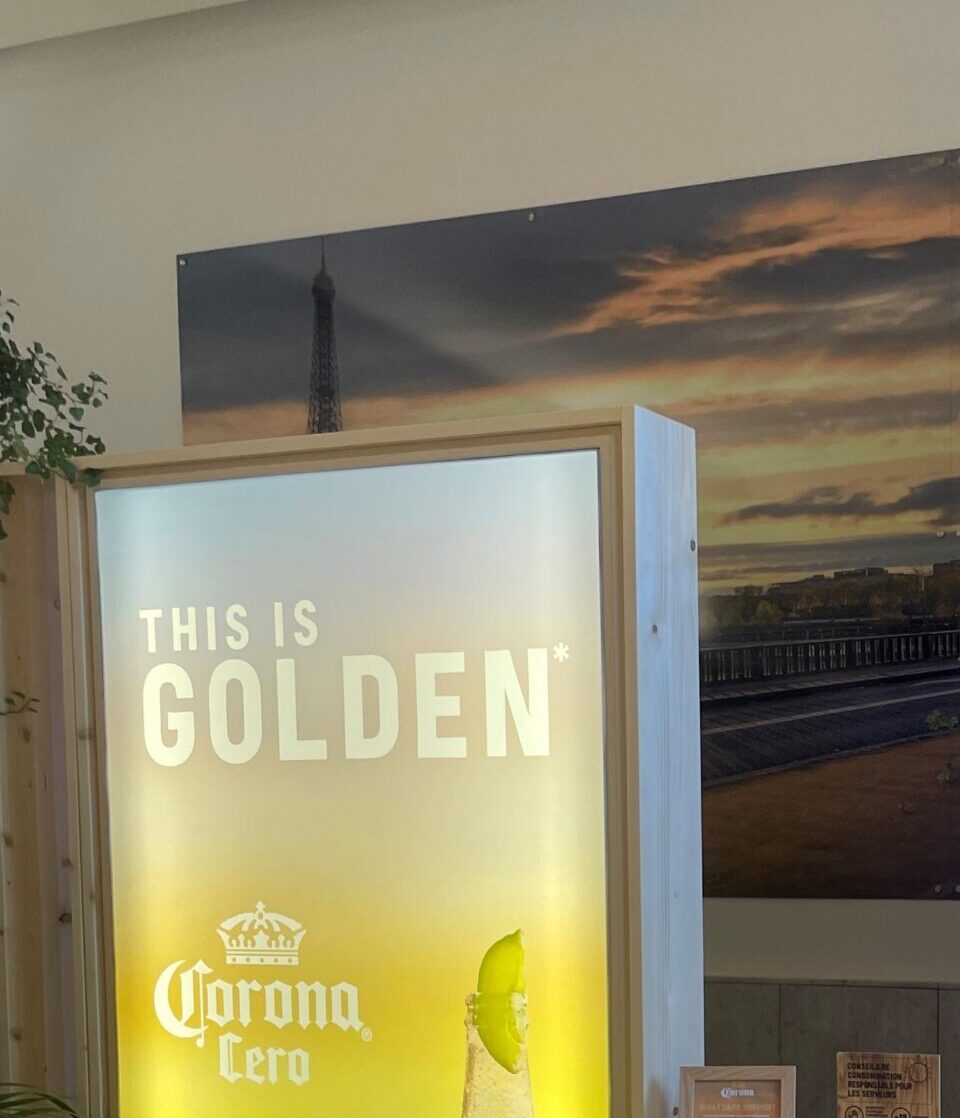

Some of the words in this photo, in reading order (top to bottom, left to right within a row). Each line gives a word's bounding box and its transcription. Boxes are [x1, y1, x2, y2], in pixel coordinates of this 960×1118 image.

[140, 603, 249, 653] THIS
[274, 599, 318, 647] IS
[153, 959, 365, 1048] Corona
[218, 1032, 311, 1086] Cero
